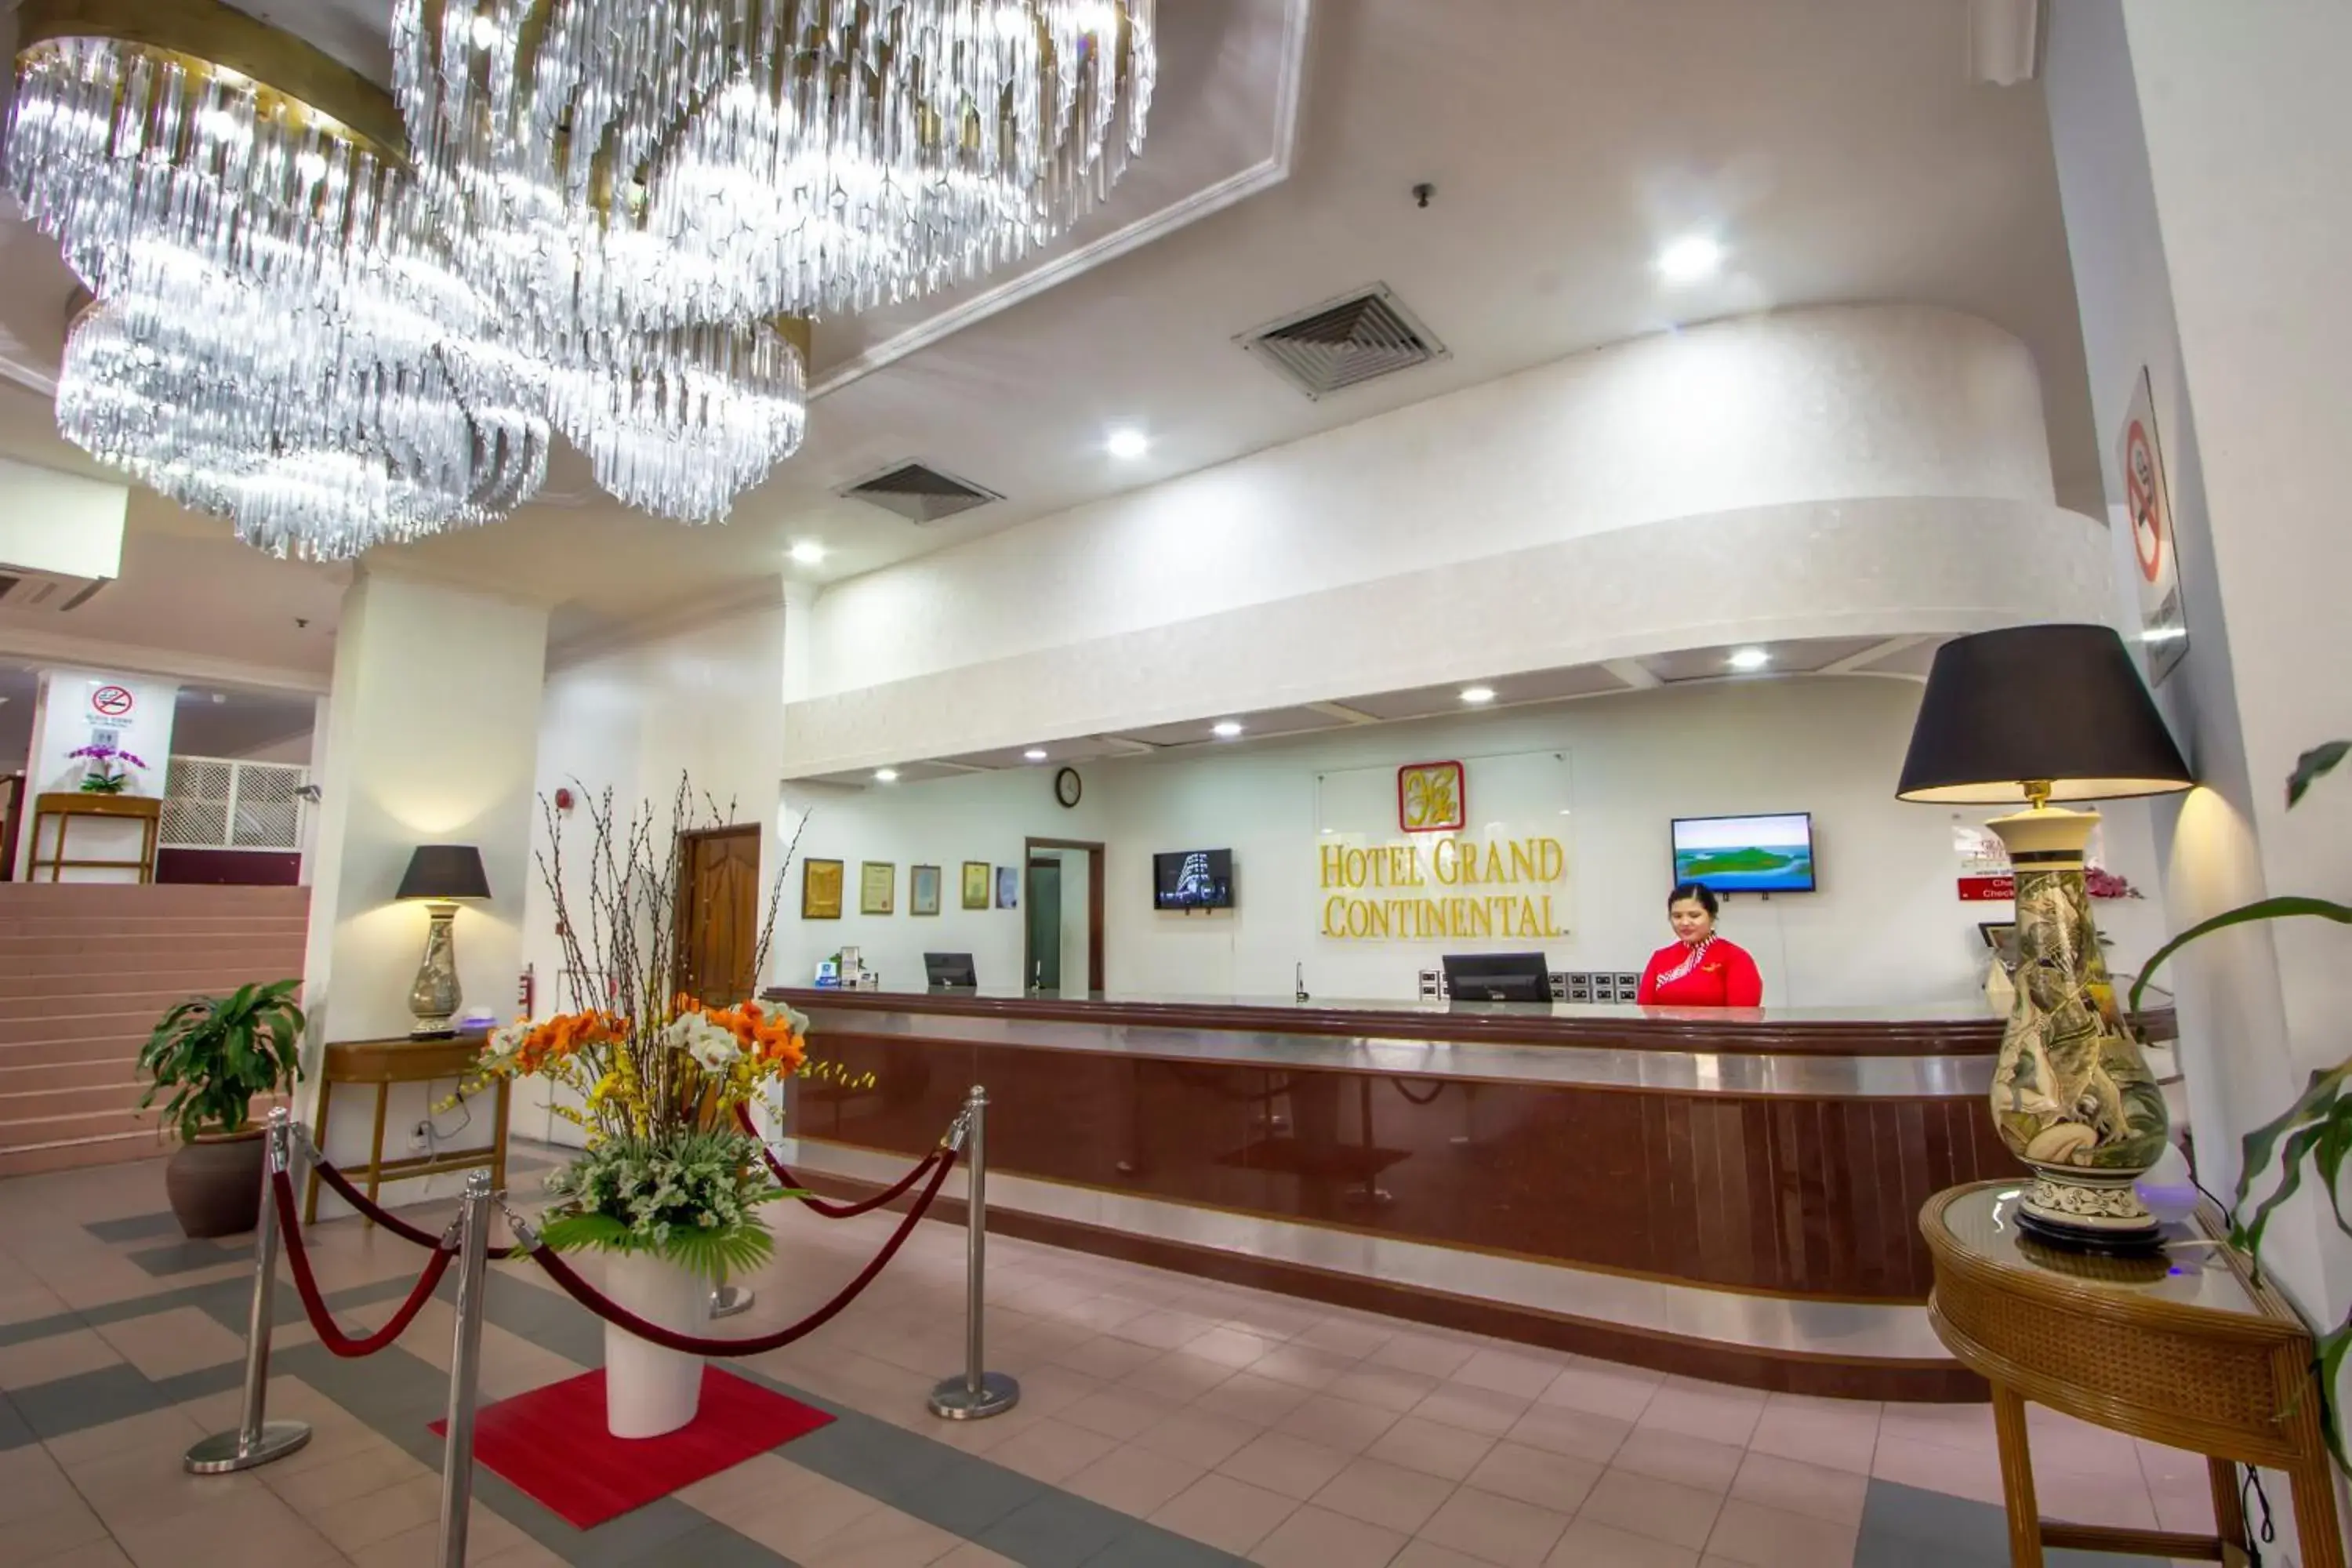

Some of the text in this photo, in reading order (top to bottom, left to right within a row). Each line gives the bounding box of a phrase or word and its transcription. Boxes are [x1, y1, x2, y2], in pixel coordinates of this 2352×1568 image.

[1319, 838, 1563, 888] HOTEL GRAND
[1324, 895, 1560, 938] CONTINENTAL
